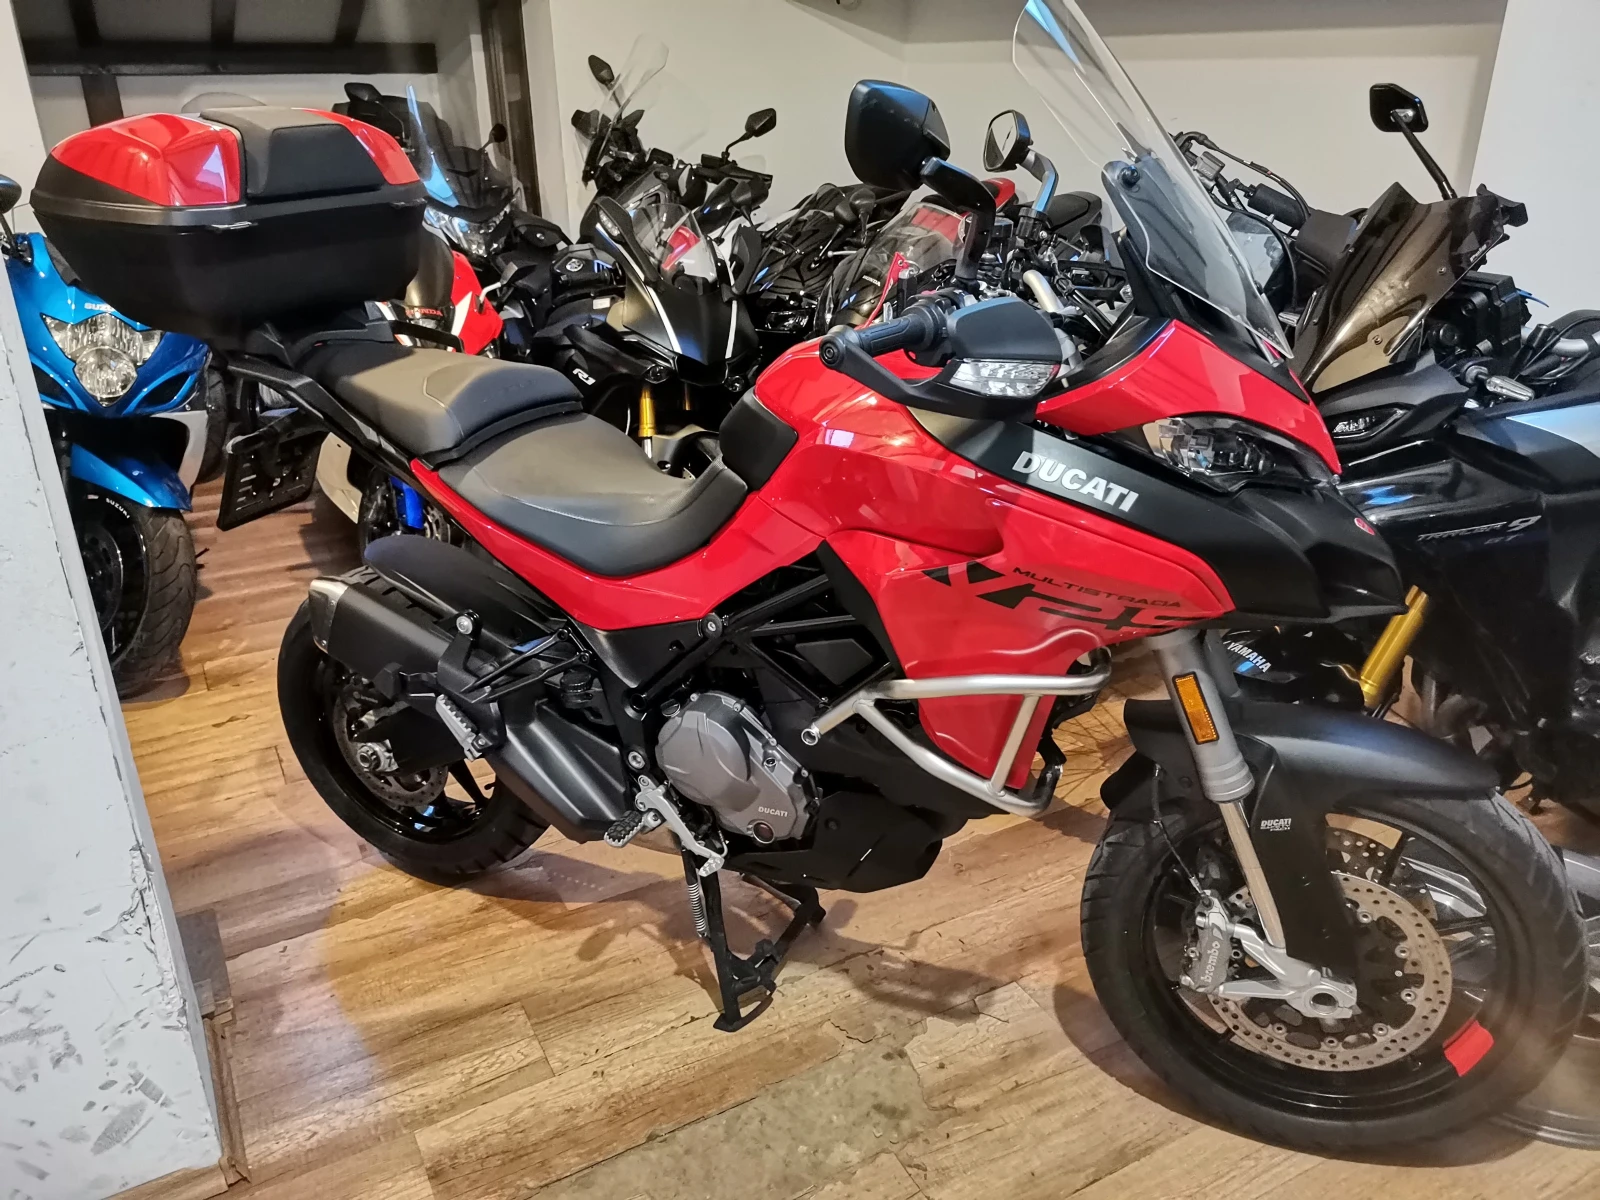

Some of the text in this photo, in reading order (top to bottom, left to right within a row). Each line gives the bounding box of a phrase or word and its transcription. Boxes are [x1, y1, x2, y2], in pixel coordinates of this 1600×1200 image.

[862, 275, 881, 287] HONDA
[84, 303, 116, 312] SUZU
[572, 368, 596, 386] R1
[1012, 451, 1139, 512] DUCATI
[106, 498, 130, 519] SUZUKI
[1417, 515, 1542, 542] TRACER 9
[1013, 566, 1182, 609] MULTISTRADA
[1227, 642, 1271, 672] YAMAHA
[758, 806, 788, 817] DUCATI
[1261, 818, 1292, 828] DUCATI
[1201, 940, 1220, 983] brembo
